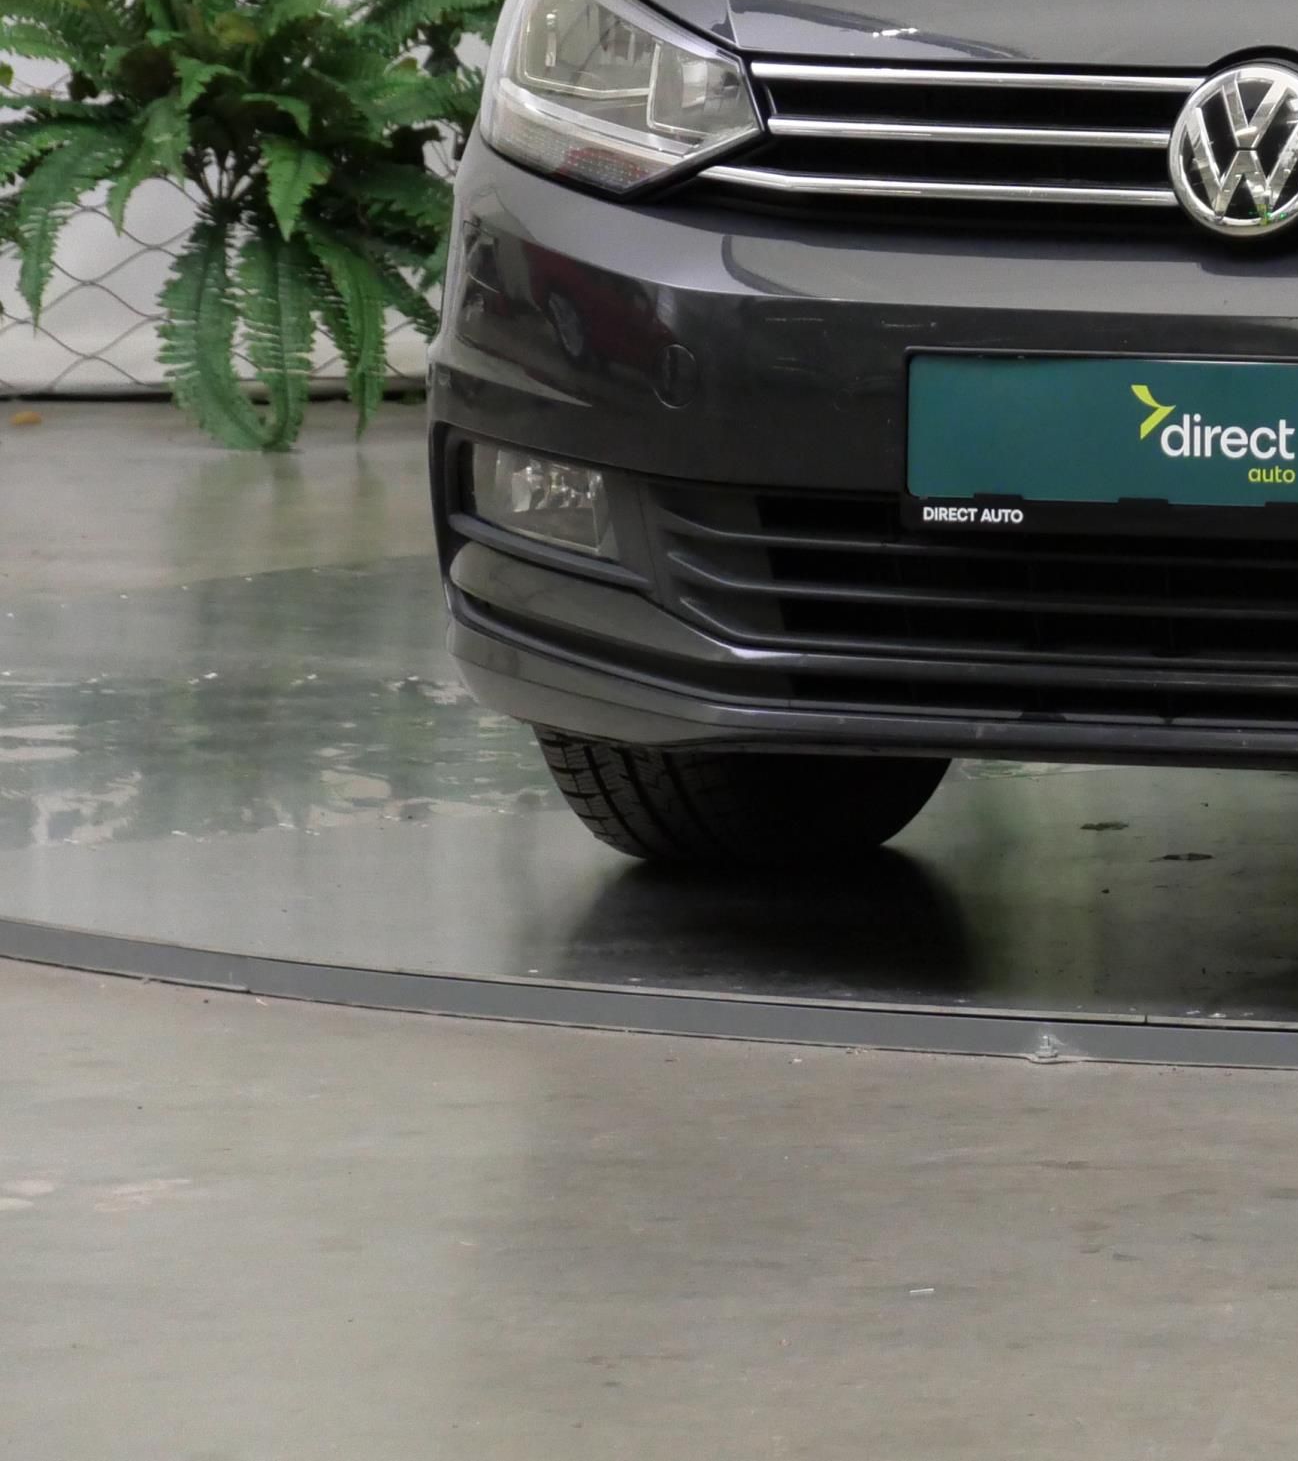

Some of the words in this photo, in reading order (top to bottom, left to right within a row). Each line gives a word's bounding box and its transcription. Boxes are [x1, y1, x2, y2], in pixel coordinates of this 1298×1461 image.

[1160, 413, 1296, 460] direct
[1247, 465, 1296, 484] auto
[922, 506, 978, 522] DIRECT
[980, 508, 1024, 524] AUTO
